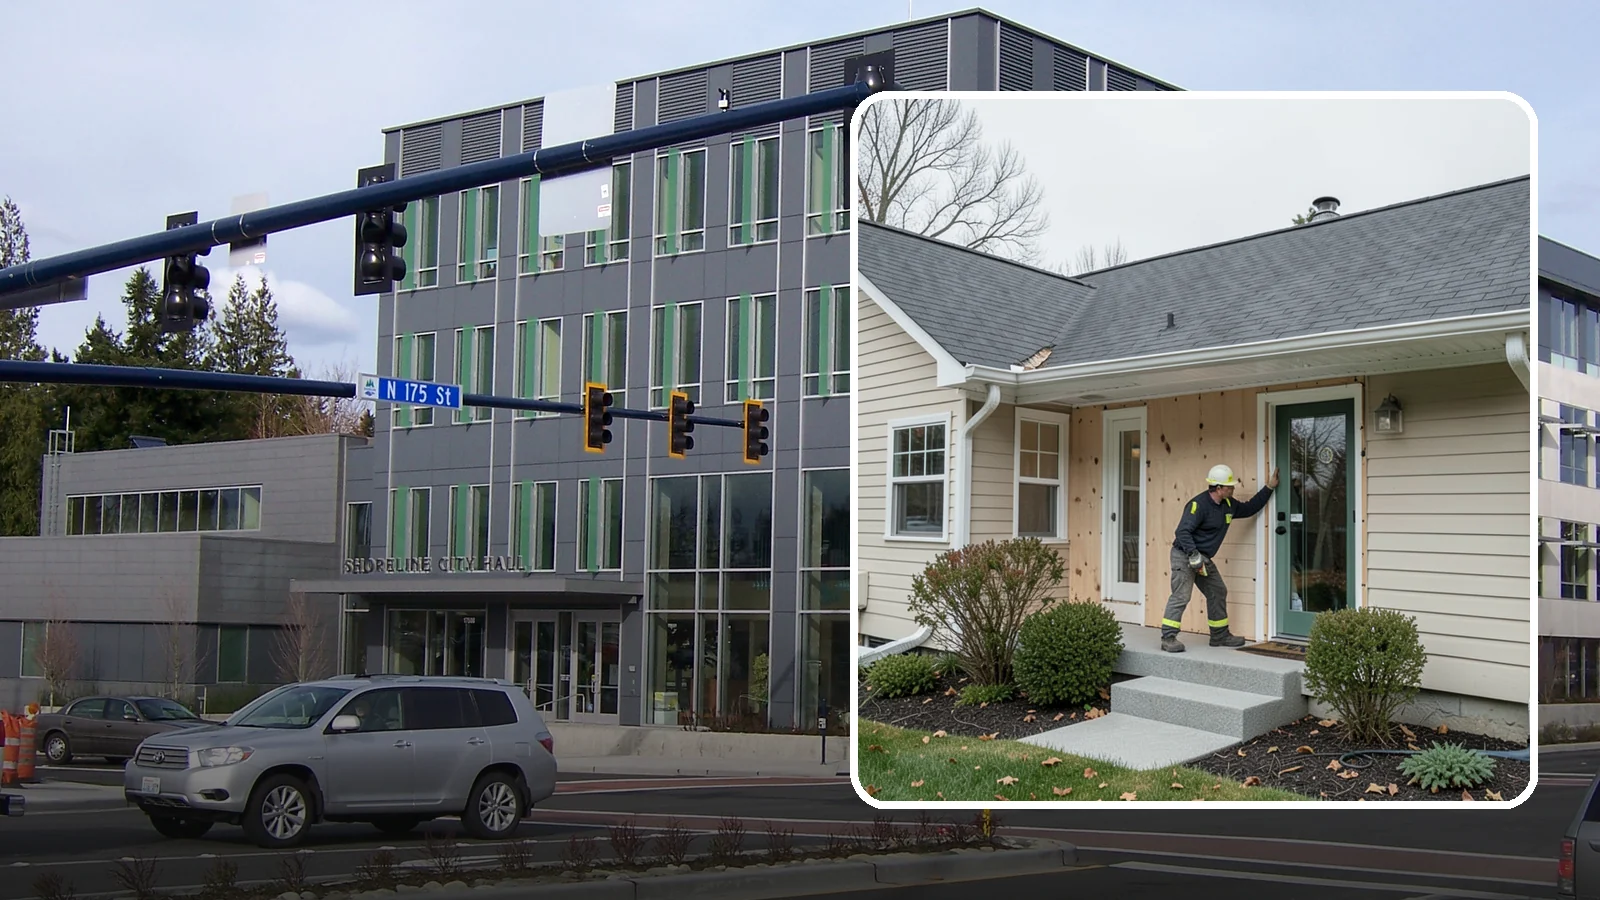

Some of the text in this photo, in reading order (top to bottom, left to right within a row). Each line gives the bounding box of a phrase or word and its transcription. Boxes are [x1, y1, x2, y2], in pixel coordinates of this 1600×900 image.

[387, 380, 451, 406] N 175 St
[344, 555, 526, 574] SHORELINE CITY HALL
